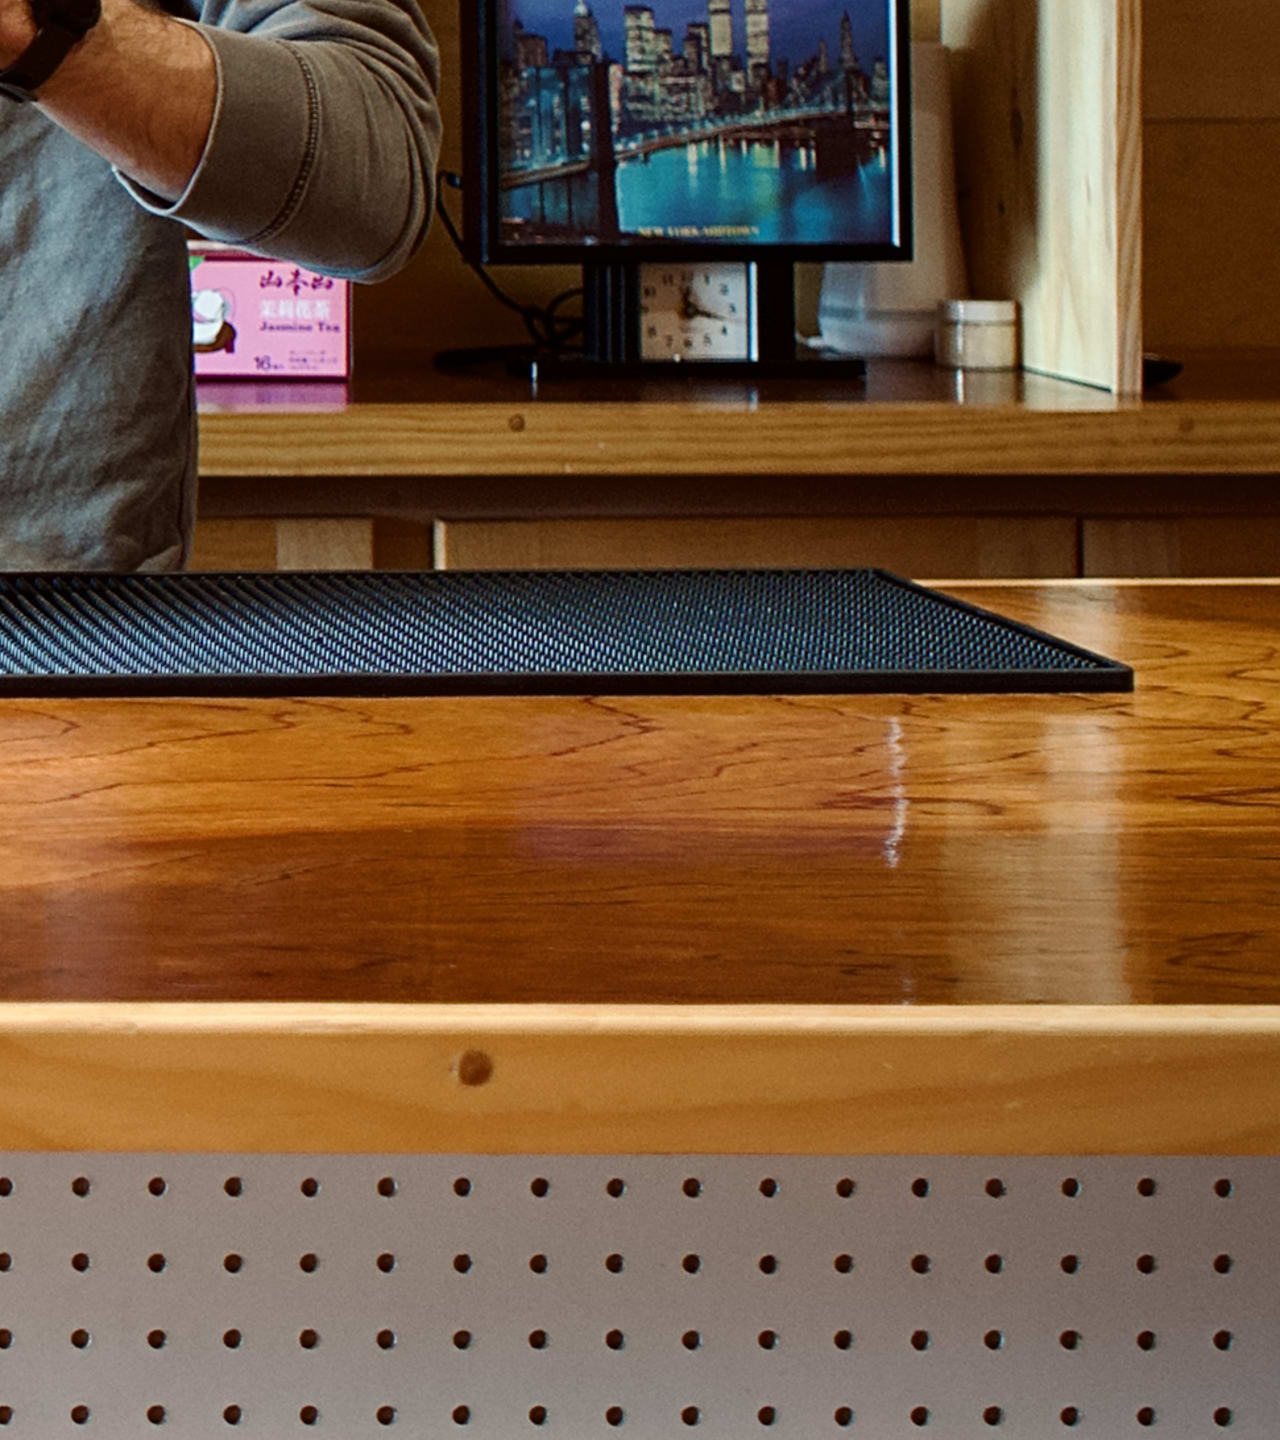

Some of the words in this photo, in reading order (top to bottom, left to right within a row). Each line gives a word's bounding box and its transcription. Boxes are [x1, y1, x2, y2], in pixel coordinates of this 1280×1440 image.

[259, 269, 334, 296] 山本山
[259, 320, 314, 333] Jasmine
[318, 321, 340, 333] Tea
